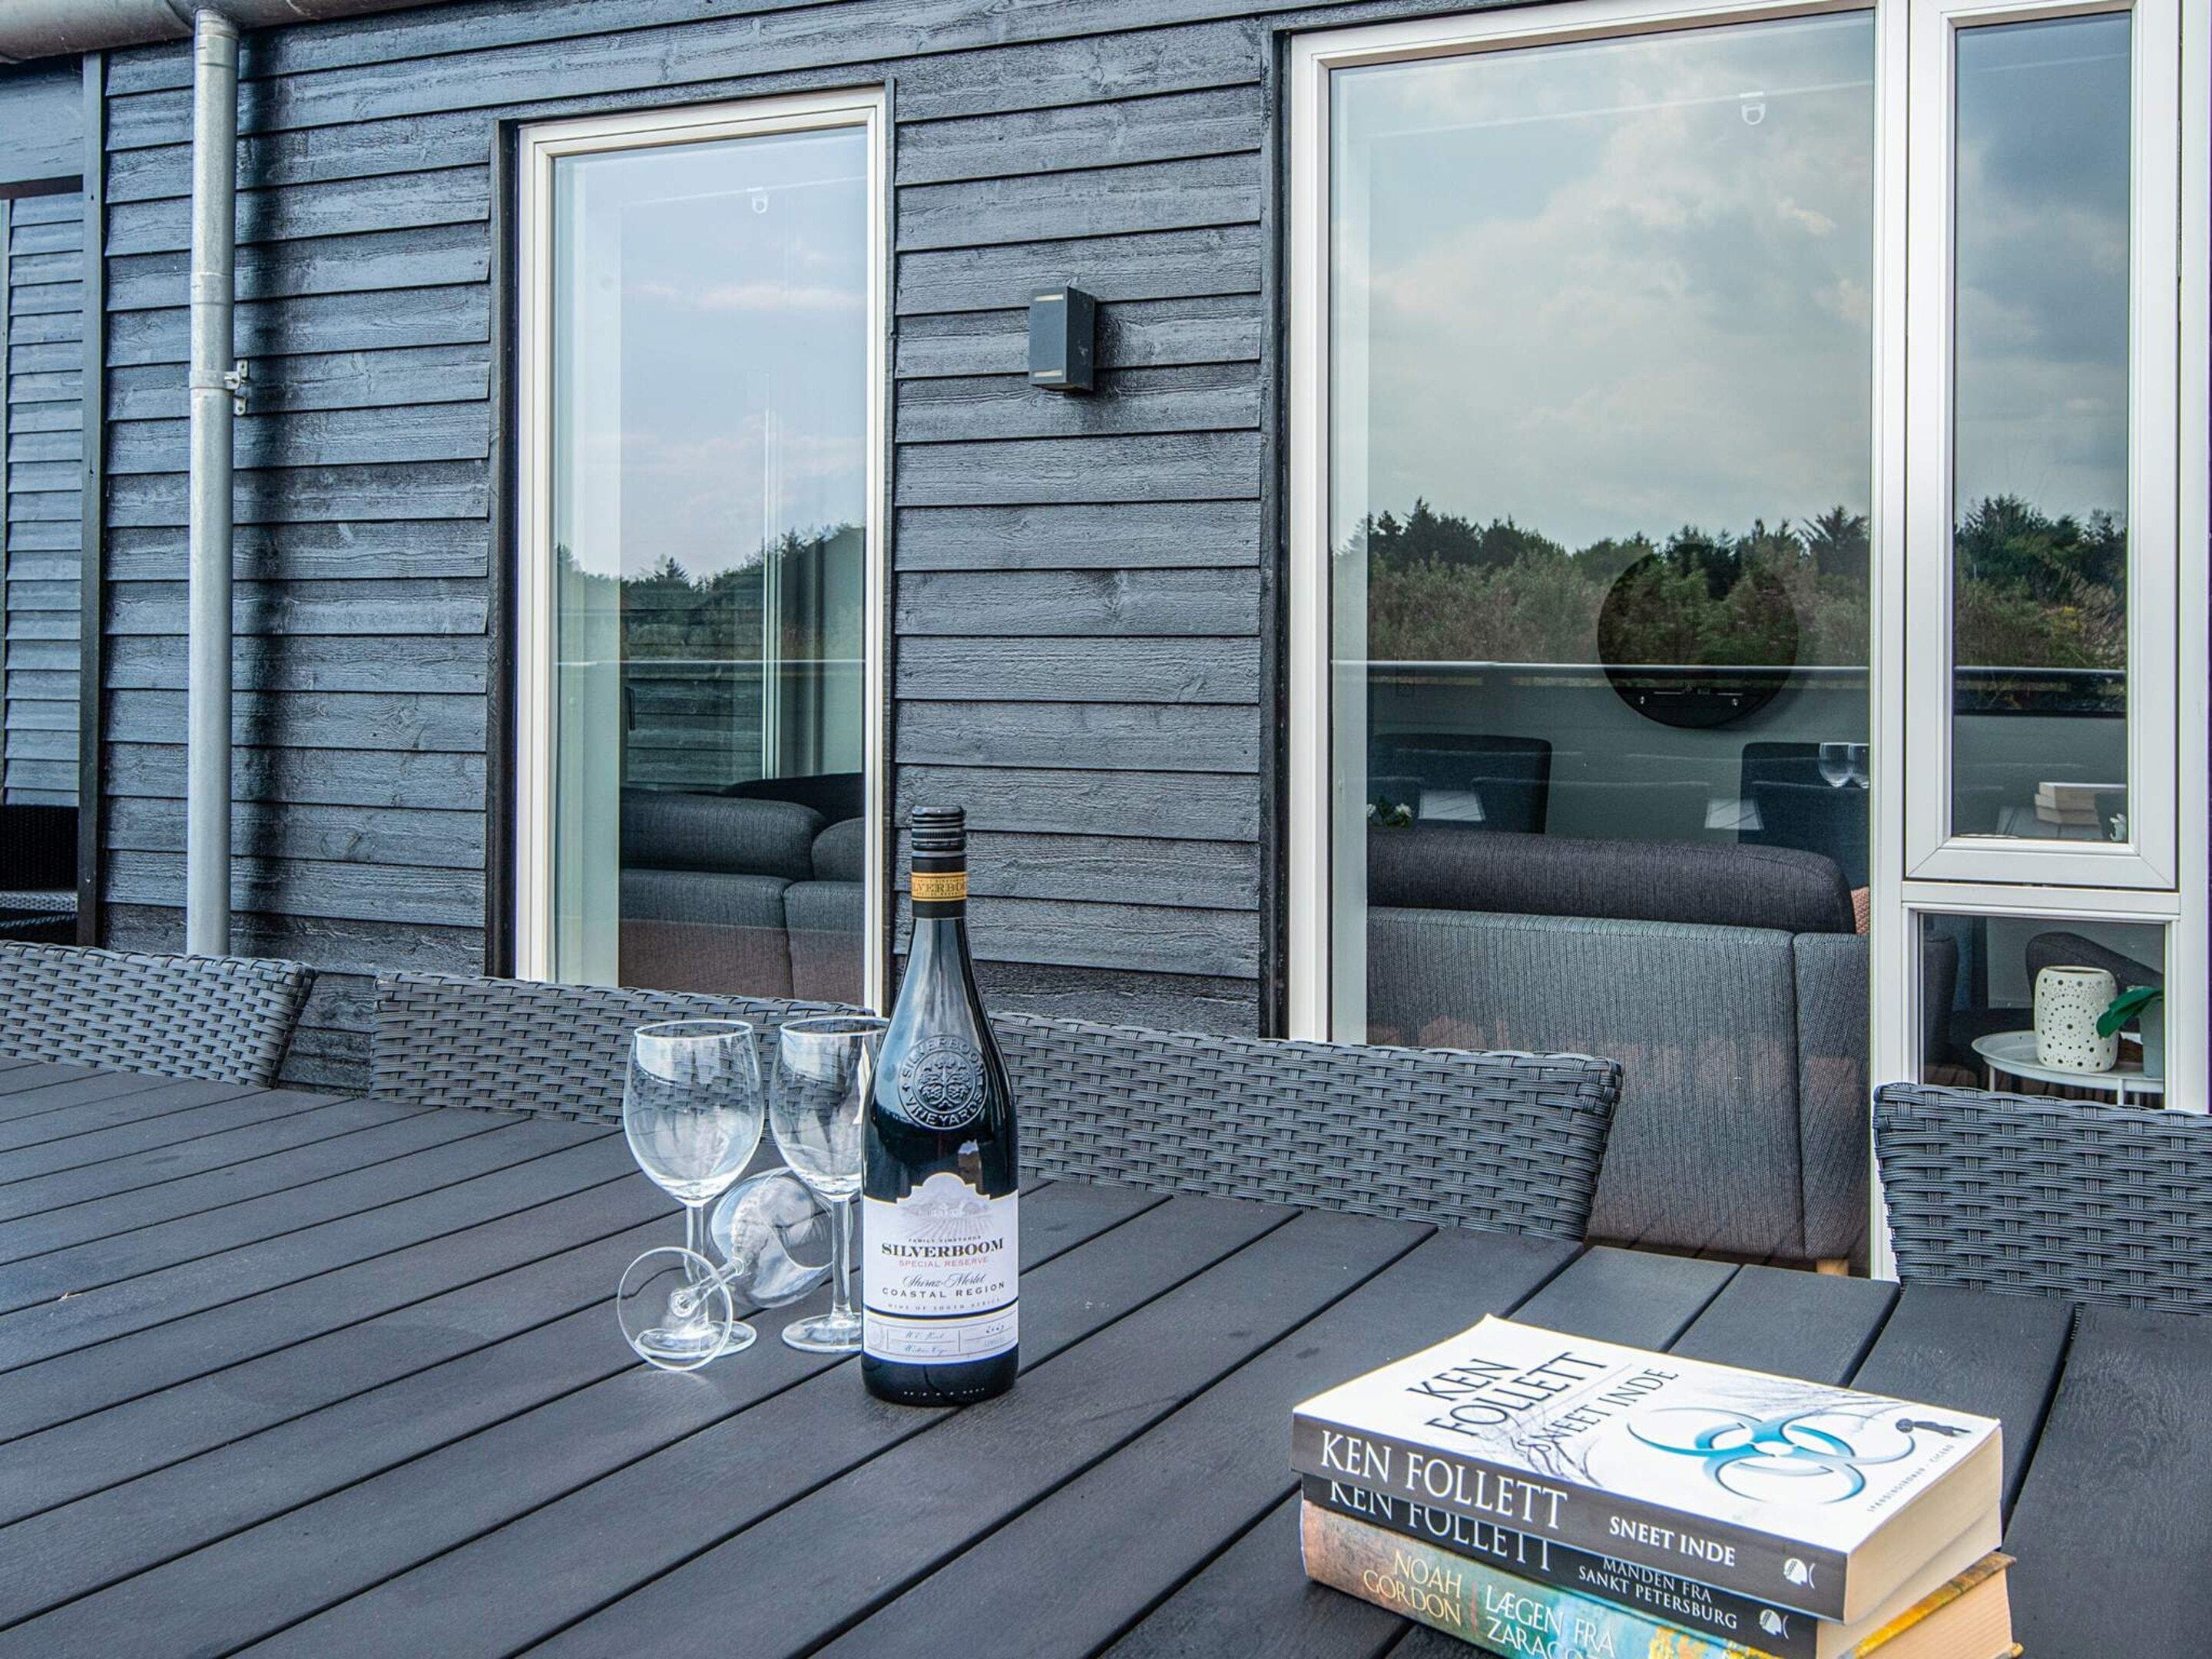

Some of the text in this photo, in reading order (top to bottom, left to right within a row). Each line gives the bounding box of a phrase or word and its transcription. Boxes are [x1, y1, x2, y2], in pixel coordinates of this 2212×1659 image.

[902, 1037, 984, 1078] SILVERBOOM
[906, 1091, 982, 1127] VINEYARDS
[882, 1237, 1004, 1259] SILVERBOOM
[899, 1256, 988, 1268] SPECIAL RESERVE
[882, 1280, 1005, 1299] COASTAL REGION
[1406, 1358, 1520, 1402] KEN
[1424, 1352, 1608, 1437] FOLLETT
[1518, 1368, 1681, 1452] SNEET INDE
[1321, 1429, 1568, 1530] KEN FOLLETT
[1330, 1480, 1551, 1572] KEN FOLLETT
[1609, 1515, 1737, 1567] SNEET INDE
[1363, 1569, 1462, 1627] GORDON
[1393, 1550, 1463, 1598] NOAH
[1578, 1565, 1738, 1630] SANKT PETERSBURG
[1602, 1557, 1713, 1604] MANDEN FRA
[1485, 1584, 1615, 1658] LÆGEN FRA
